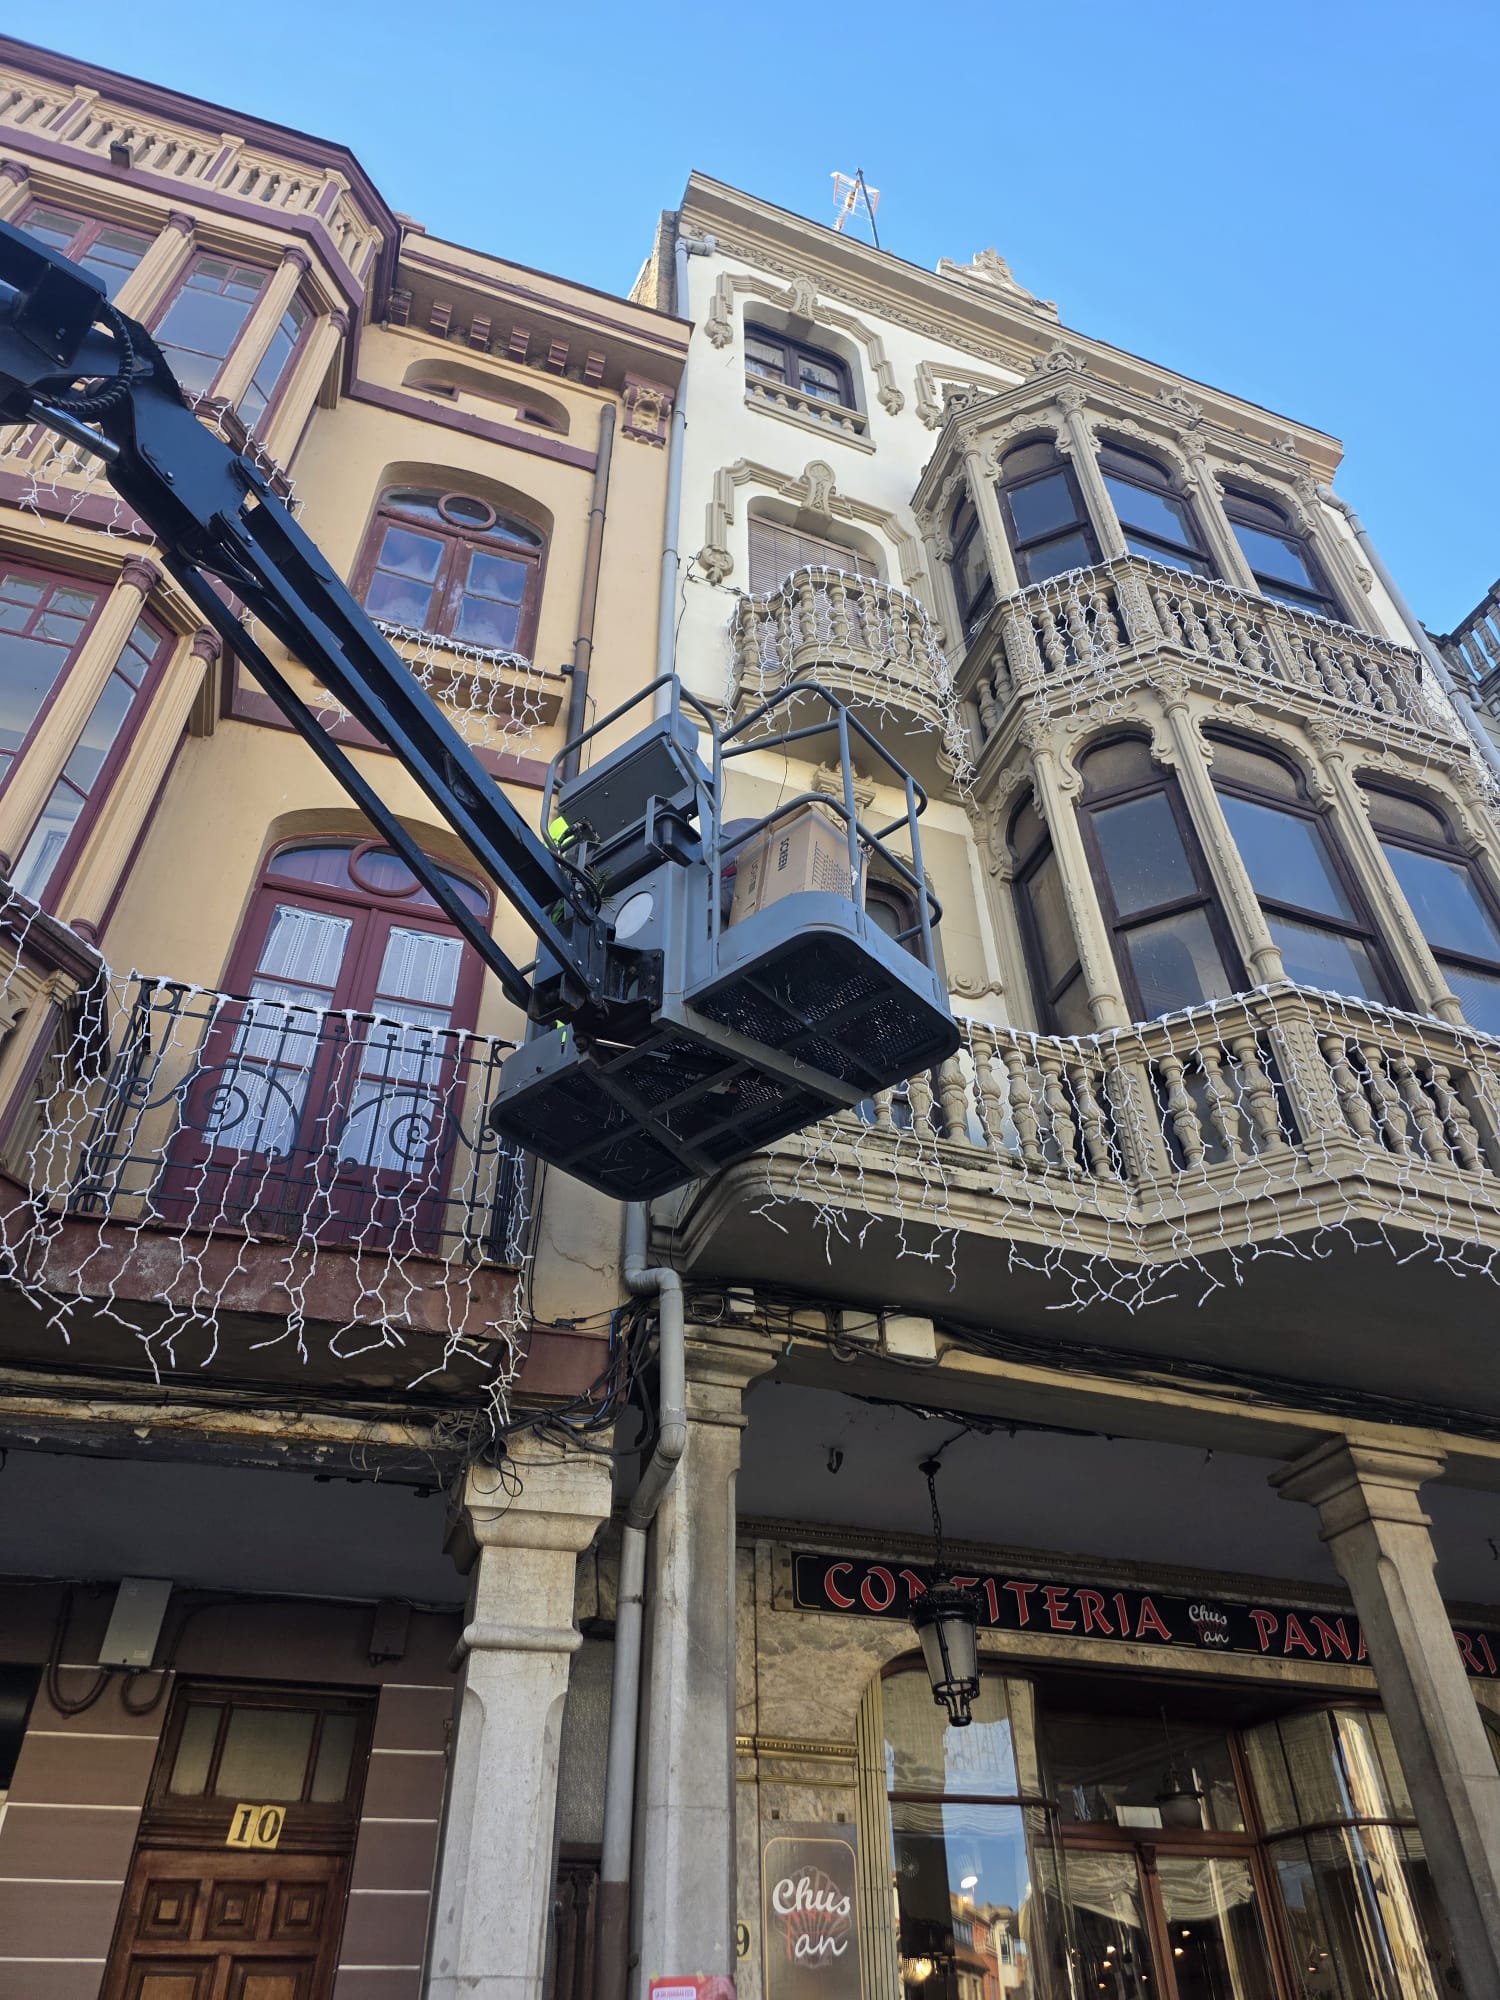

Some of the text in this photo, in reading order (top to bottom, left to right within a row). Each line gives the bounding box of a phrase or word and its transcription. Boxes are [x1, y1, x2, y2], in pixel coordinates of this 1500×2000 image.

[777, 837, 790, 872] SCREEN
[1188, 1604, 1228, 1625] Chus
[232, 1809, 281, 1843] 10
[772, 1876, 851, 1915] Chus
